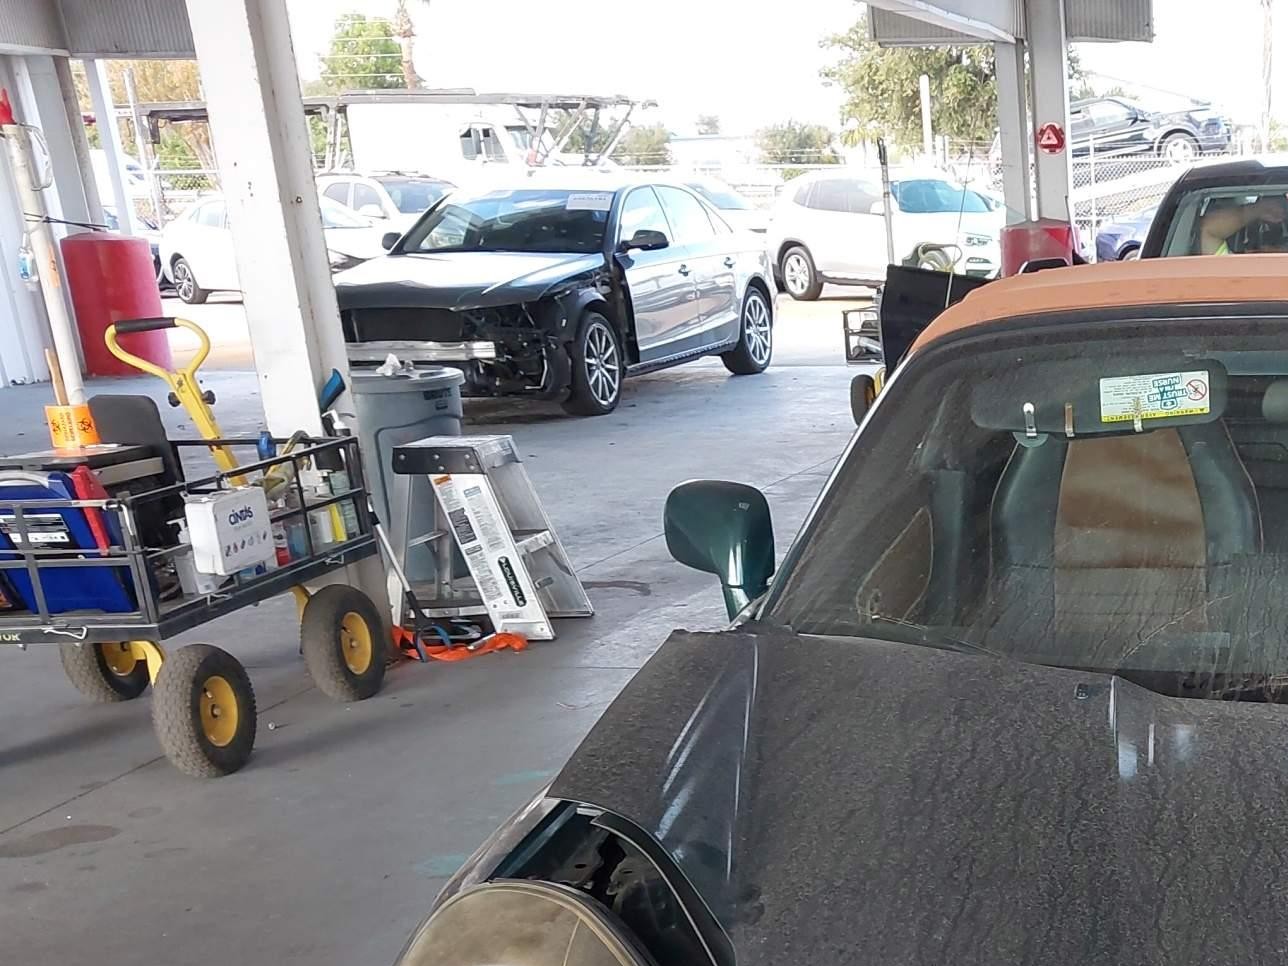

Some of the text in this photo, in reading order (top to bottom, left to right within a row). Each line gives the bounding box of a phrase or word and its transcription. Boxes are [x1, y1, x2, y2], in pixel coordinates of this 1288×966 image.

[1149, 388, 1187, 402] TRUST ME
[502, 563, 526, 607] LOUISVILLE
